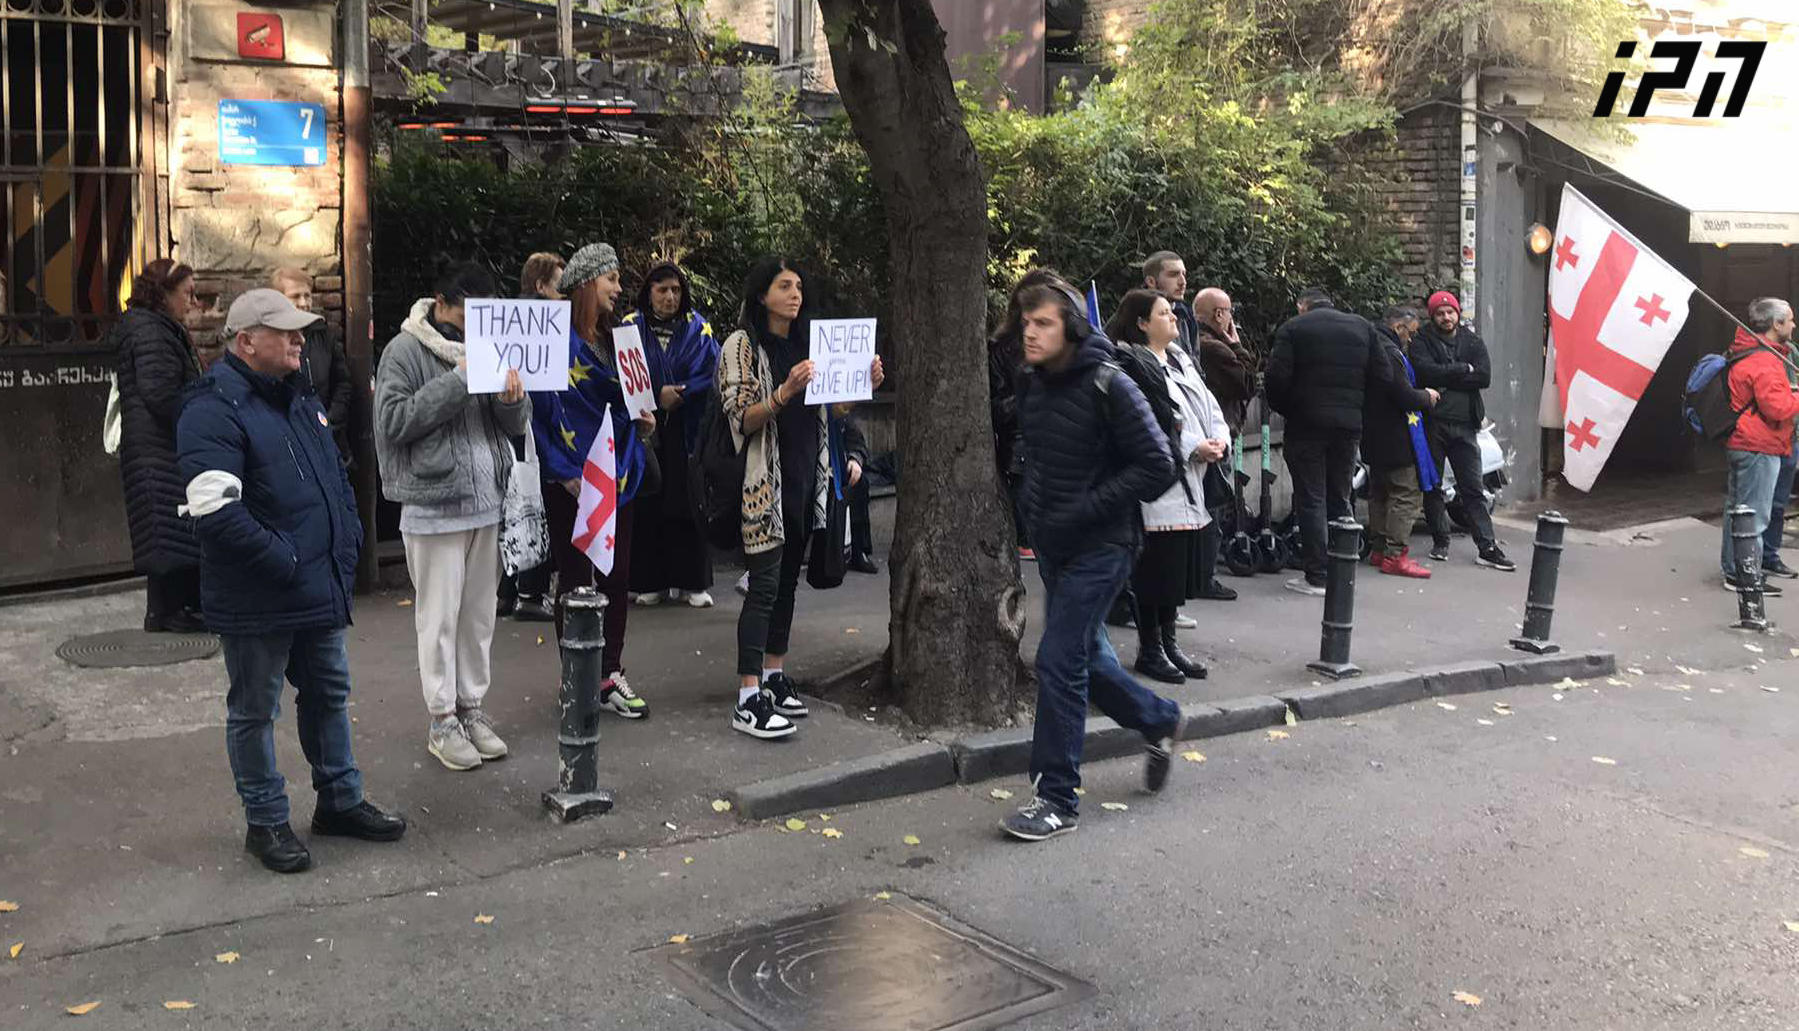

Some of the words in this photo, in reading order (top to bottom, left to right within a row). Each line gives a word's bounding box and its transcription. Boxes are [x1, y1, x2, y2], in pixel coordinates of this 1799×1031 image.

[300, 108, 314, 139] 7
[471, 305, 562, 337] THANK
[818, 324, 871, 355] NEVER
[494, 342, 549, 375] YOU!
[618, 347, 651, 396] SOS
[811, 370, 842, 396] GIVE
[846, 370, 868, 394] UP!
